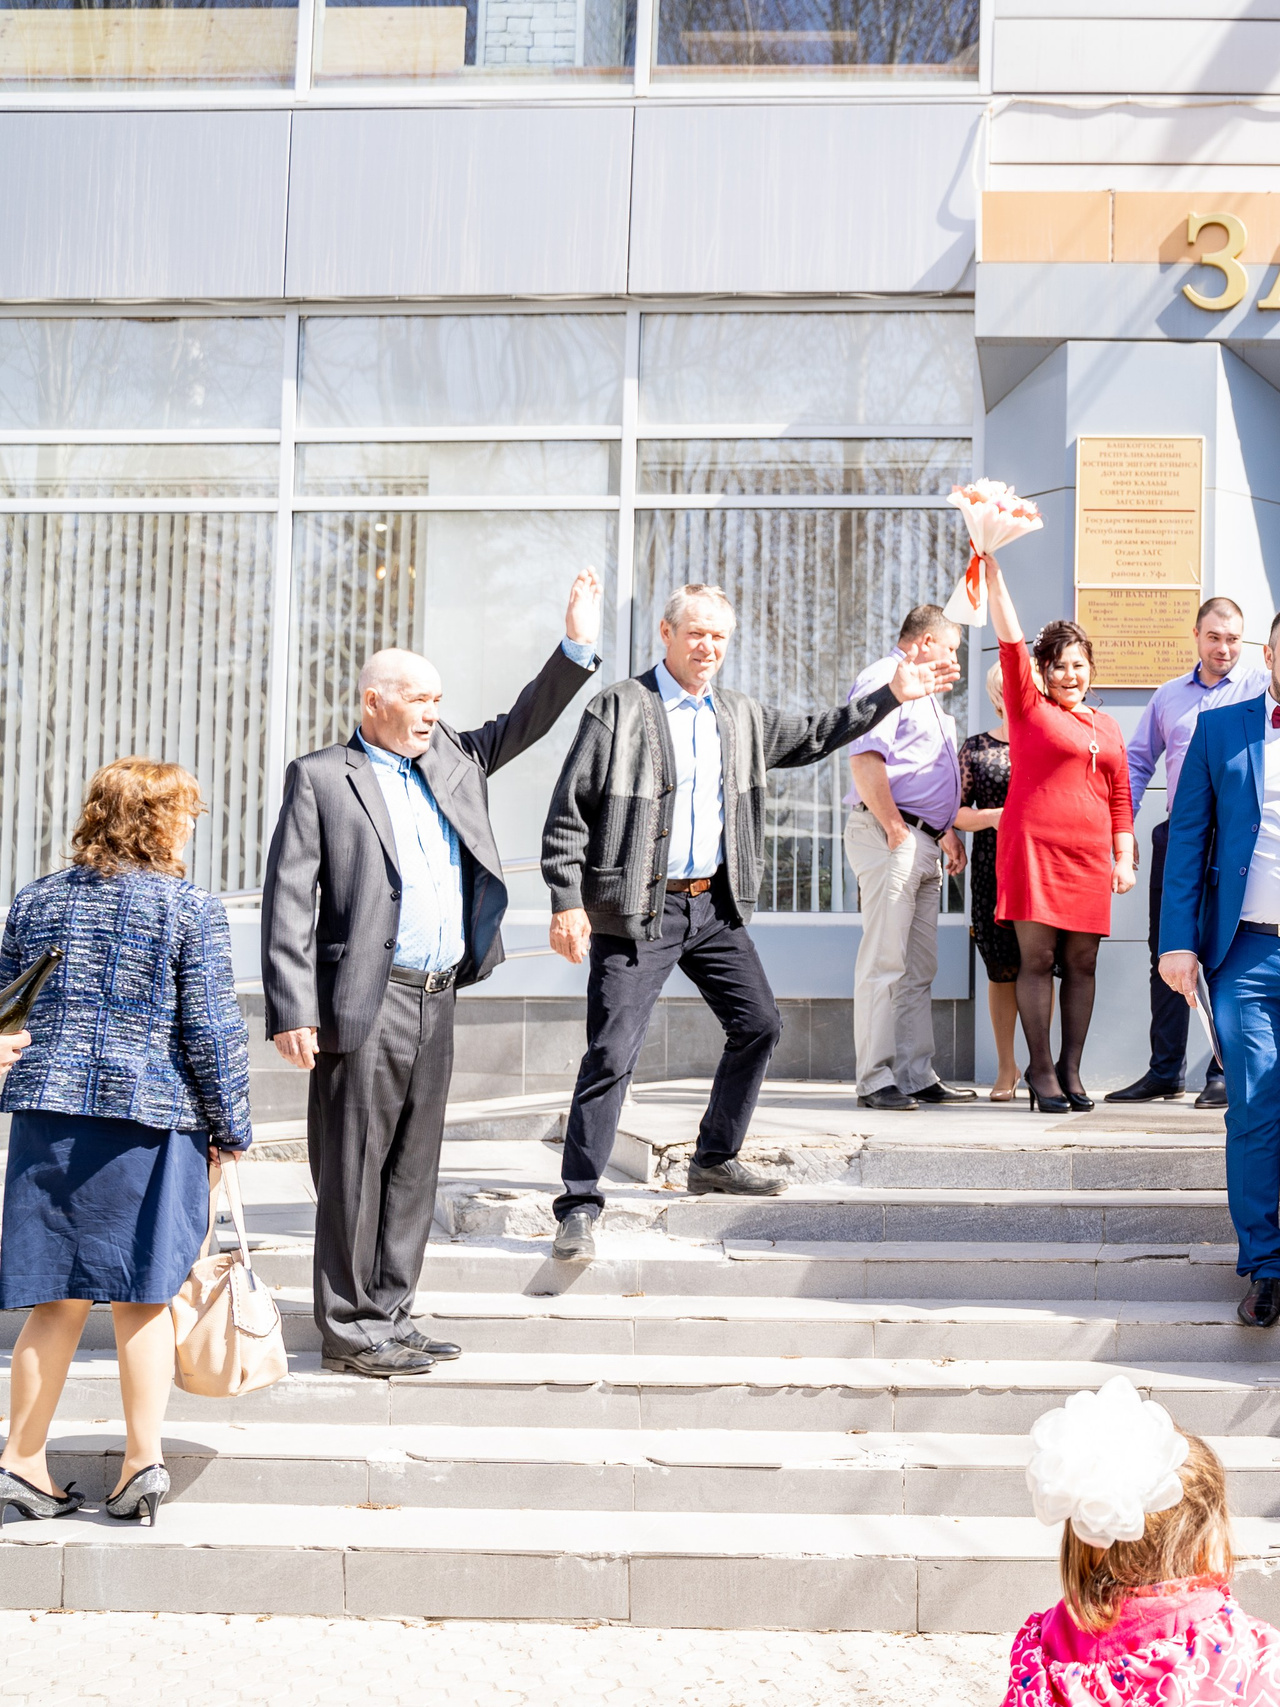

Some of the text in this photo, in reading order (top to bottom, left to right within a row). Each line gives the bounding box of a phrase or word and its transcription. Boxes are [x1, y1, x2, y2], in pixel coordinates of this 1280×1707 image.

[1086, 517, 1157, 525] Государственный
[1085, 527, 1194, 536] Республики Башкортостан
[1150, 570, 1167, 579] Уфа
[1099, 640, 1135, 648] РЕЖИМ
